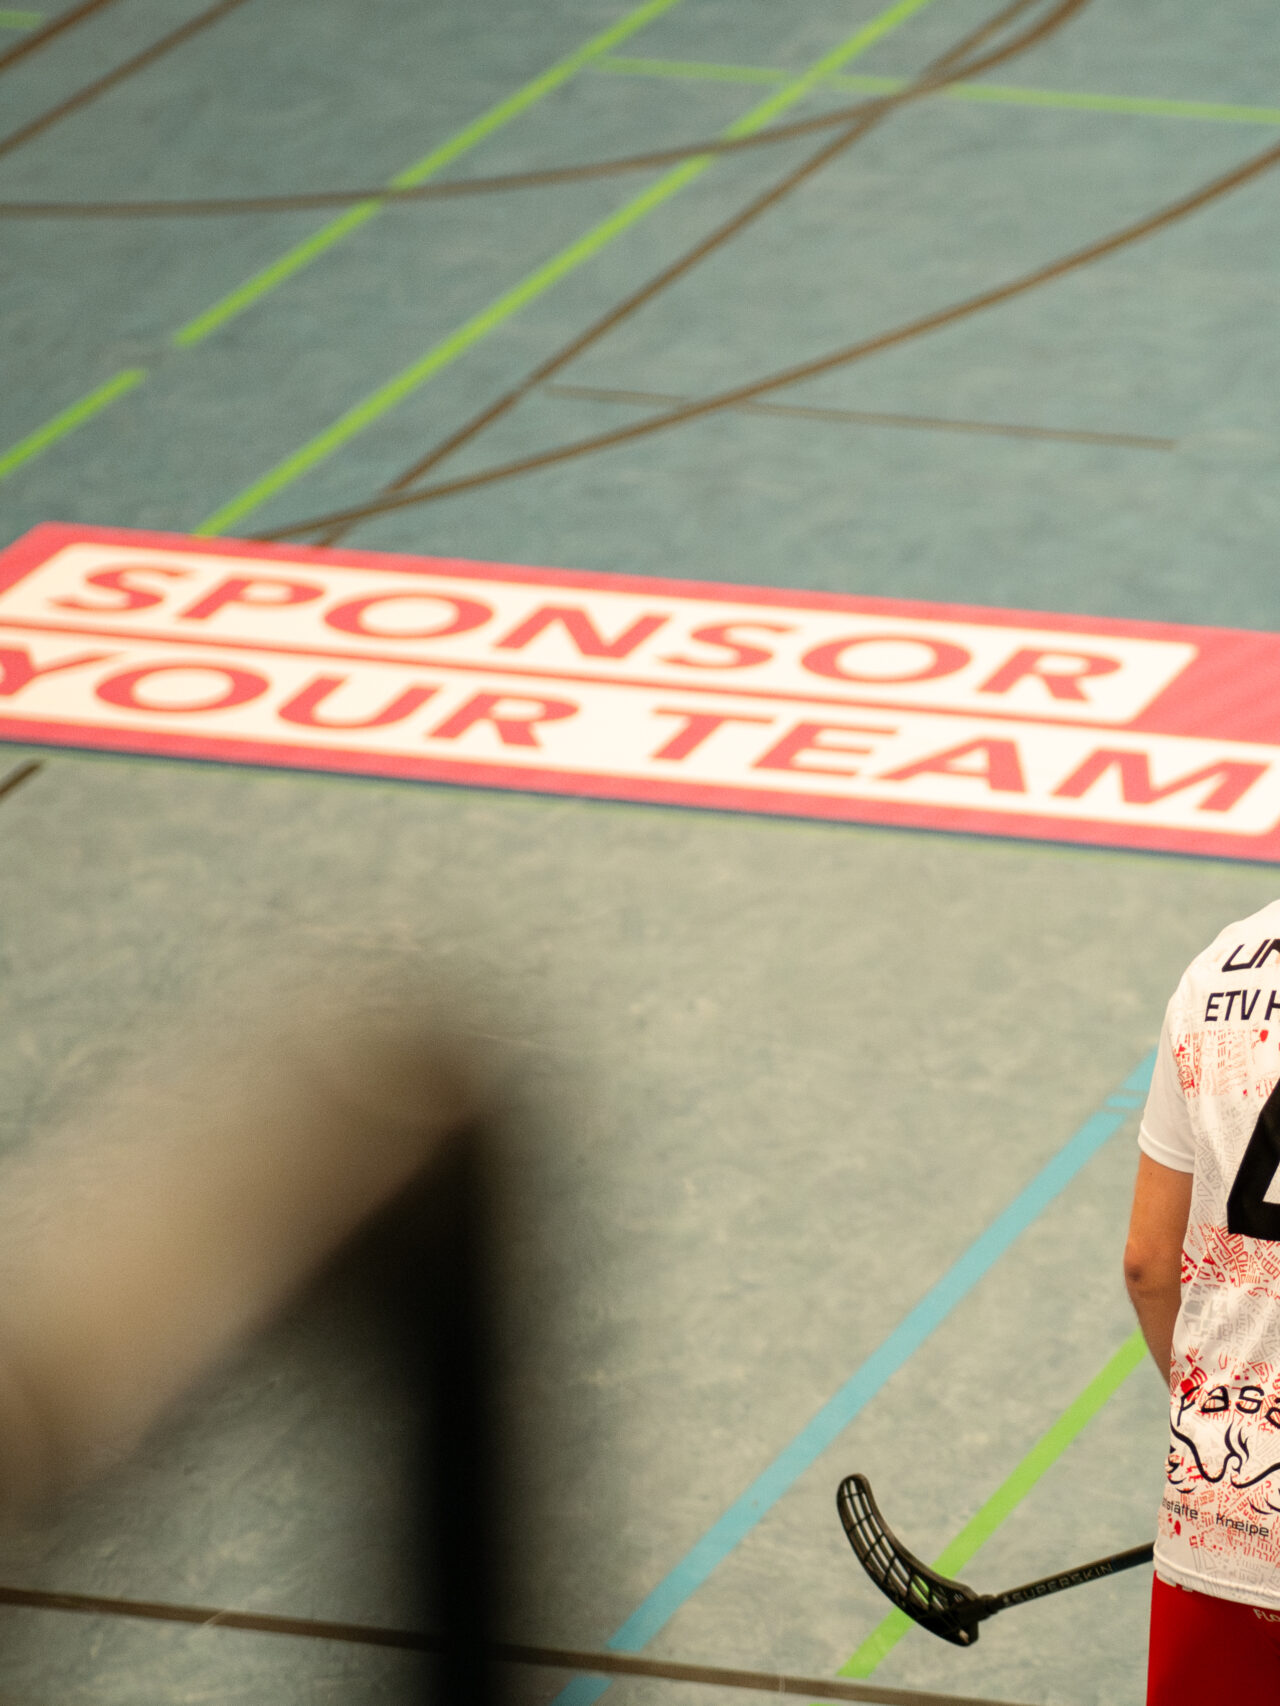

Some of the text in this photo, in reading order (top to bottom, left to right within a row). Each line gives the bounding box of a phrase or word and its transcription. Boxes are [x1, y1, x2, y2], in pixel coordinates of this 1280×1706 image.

[50, 564, 1122, 703] SPONSOR
[0, 641, 1271, 813] YOUR TEAM
[1204, 989, 1261, 1022] ETV
[1216, 1513, 1270, 1537] Kneipe
